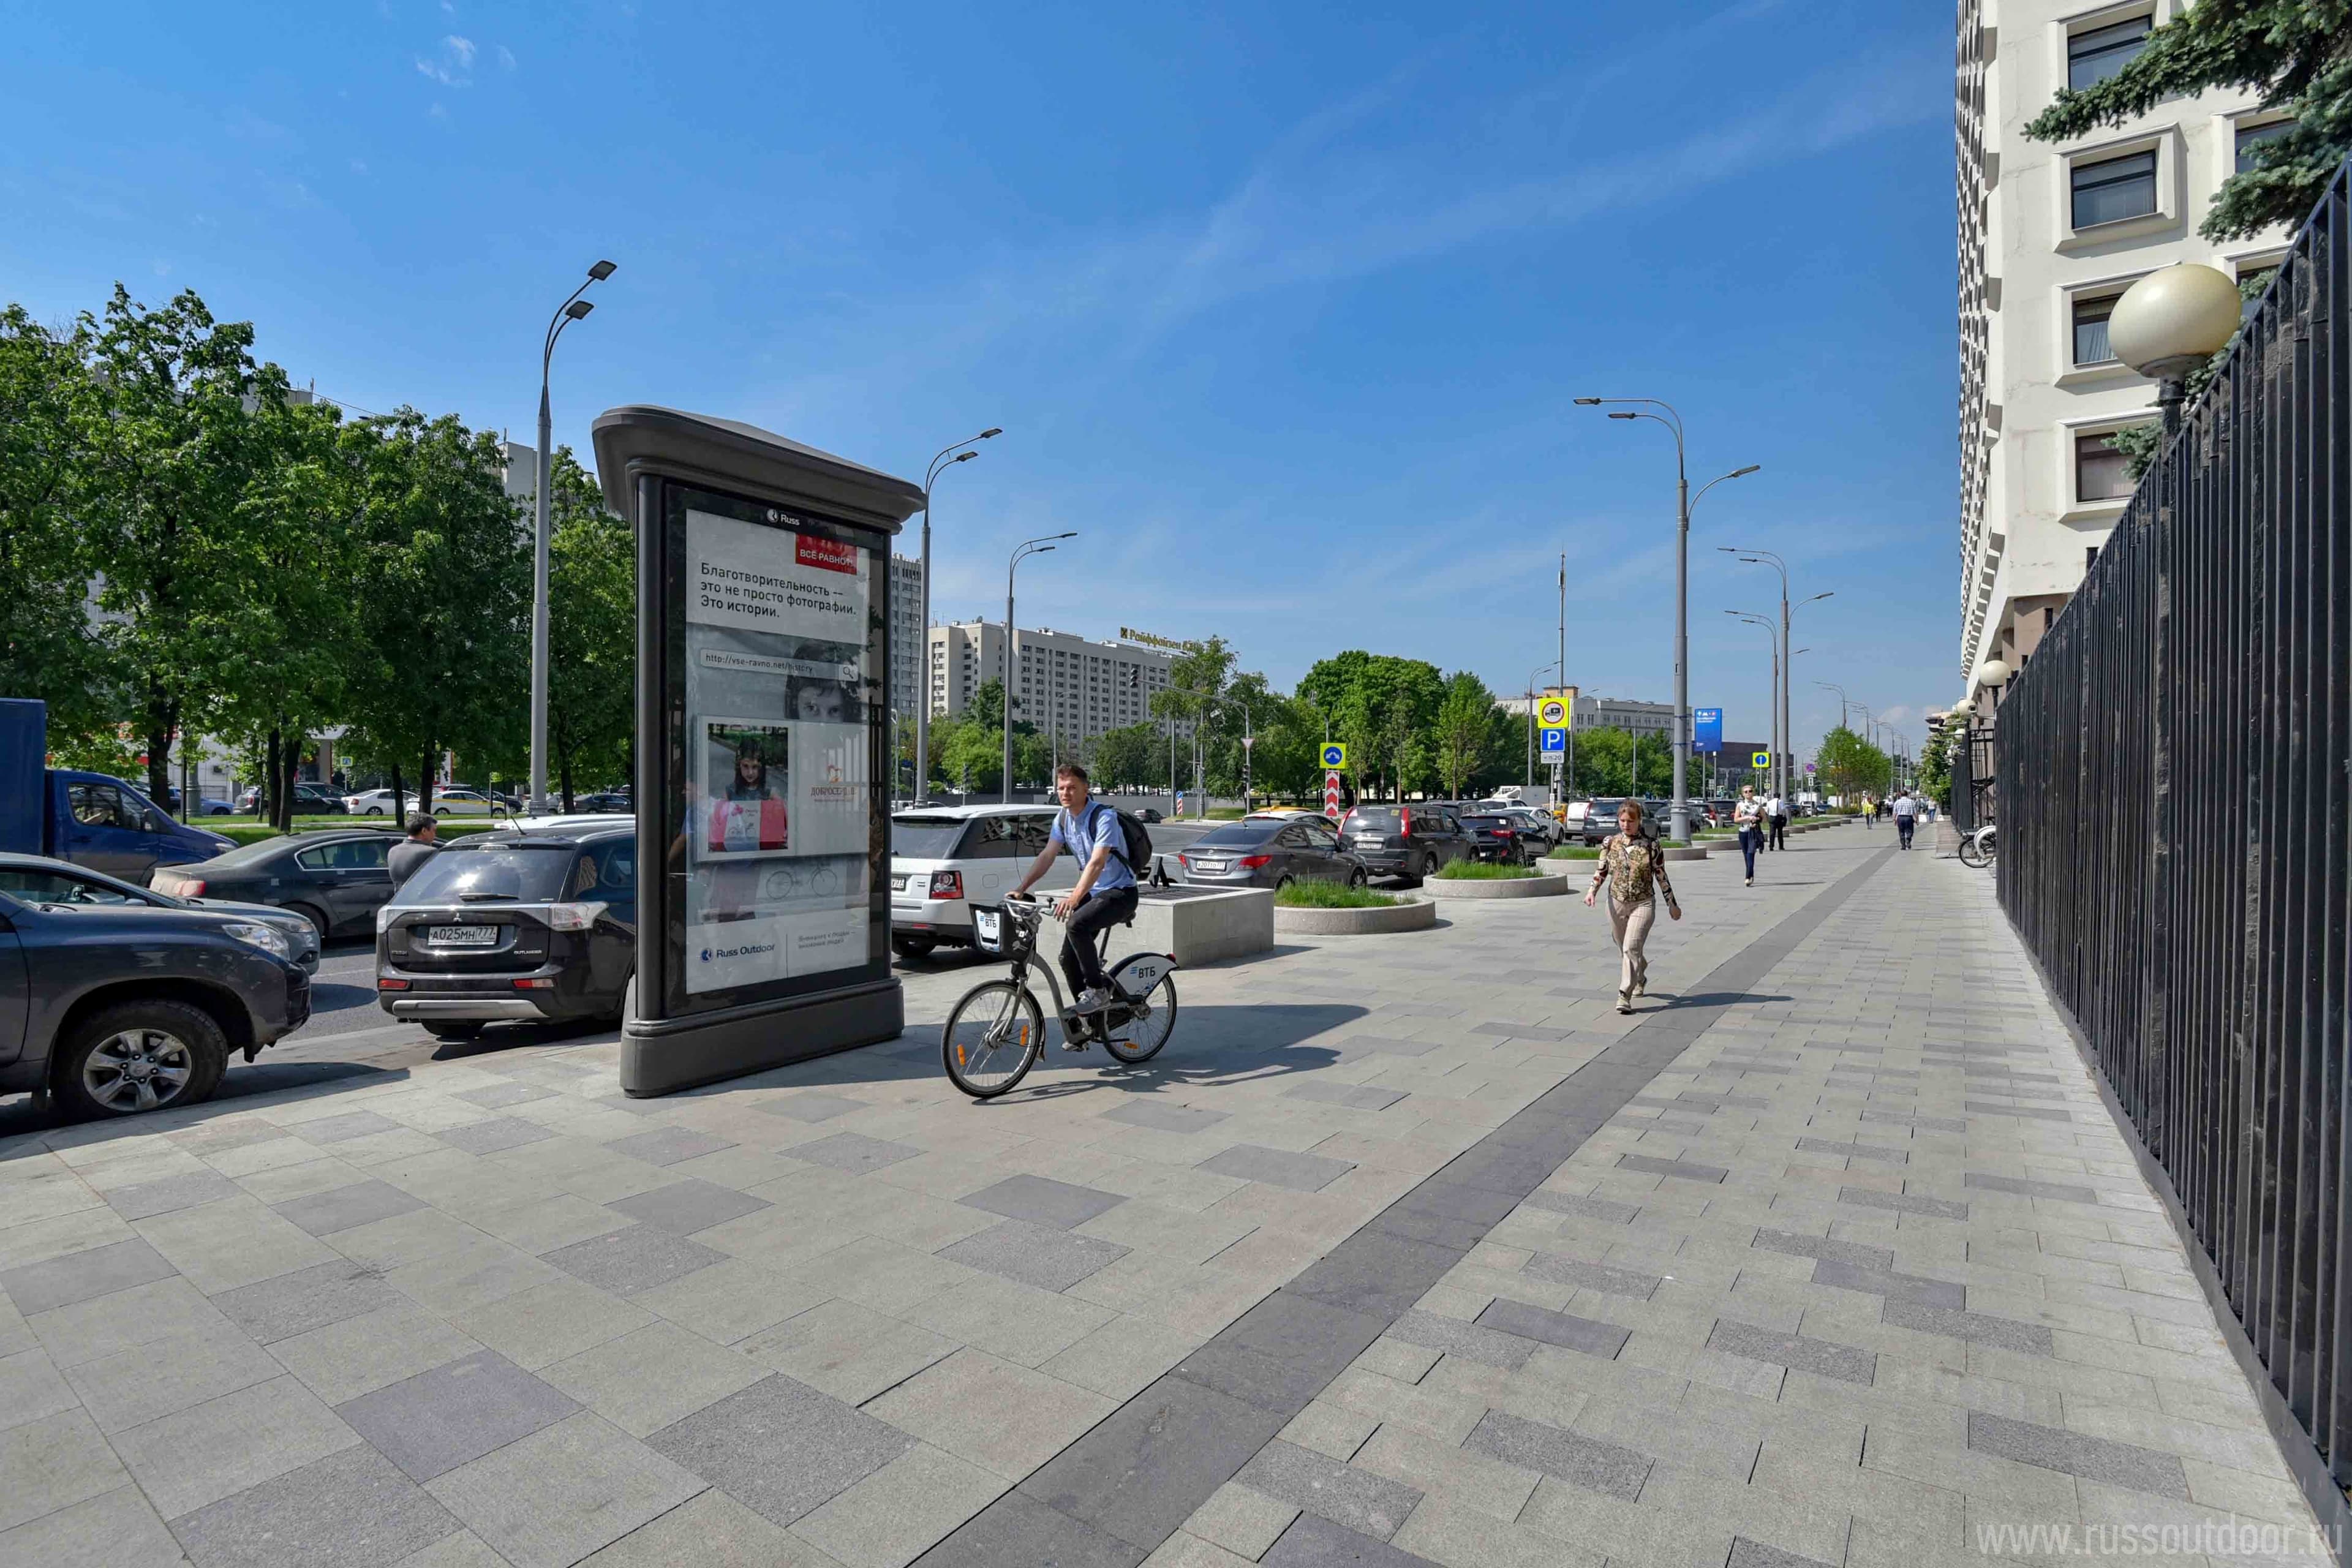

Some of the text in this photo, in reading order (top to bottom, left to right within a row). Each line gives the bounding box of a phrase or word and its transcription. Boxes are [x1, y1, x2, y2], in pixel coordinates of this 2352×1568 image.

[780, 514, 800, 526] Russ
[701, 562, 830, 597] Благотворительность
[701, 581, 857, 615] это не просто фотографии.
[701, 595, 780, 618] Это истории.
[706, 653, 813, 673] http://vse-ravno.net/history
[1547, 731, 1561, 750] P
[985, 918, 997, 928] ВТБ
[716, 944, 775, 959] Russ Outdoor
[1138, 966, 1156, 979] ВТБ
